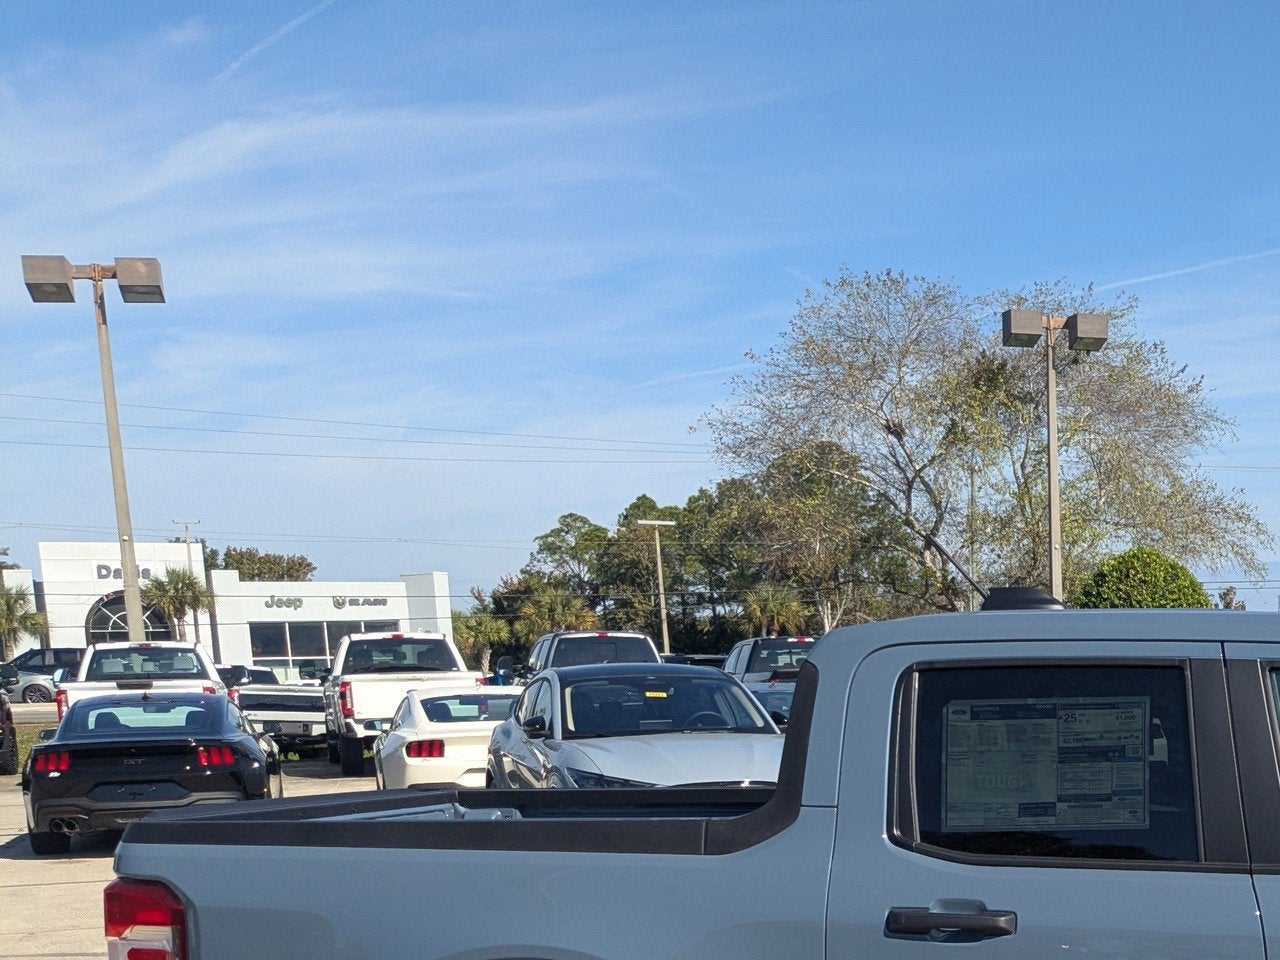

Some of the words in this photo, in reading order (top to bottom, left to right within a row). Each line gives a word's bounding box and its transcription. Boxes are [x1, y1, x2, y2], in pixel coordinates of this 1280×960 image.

[97, 564, 151, 580] Dais
[264, 595, 303, 610] Jeep
[348, 598, 388, 607] RAM
[1063, 713, 1077, 723] 25
